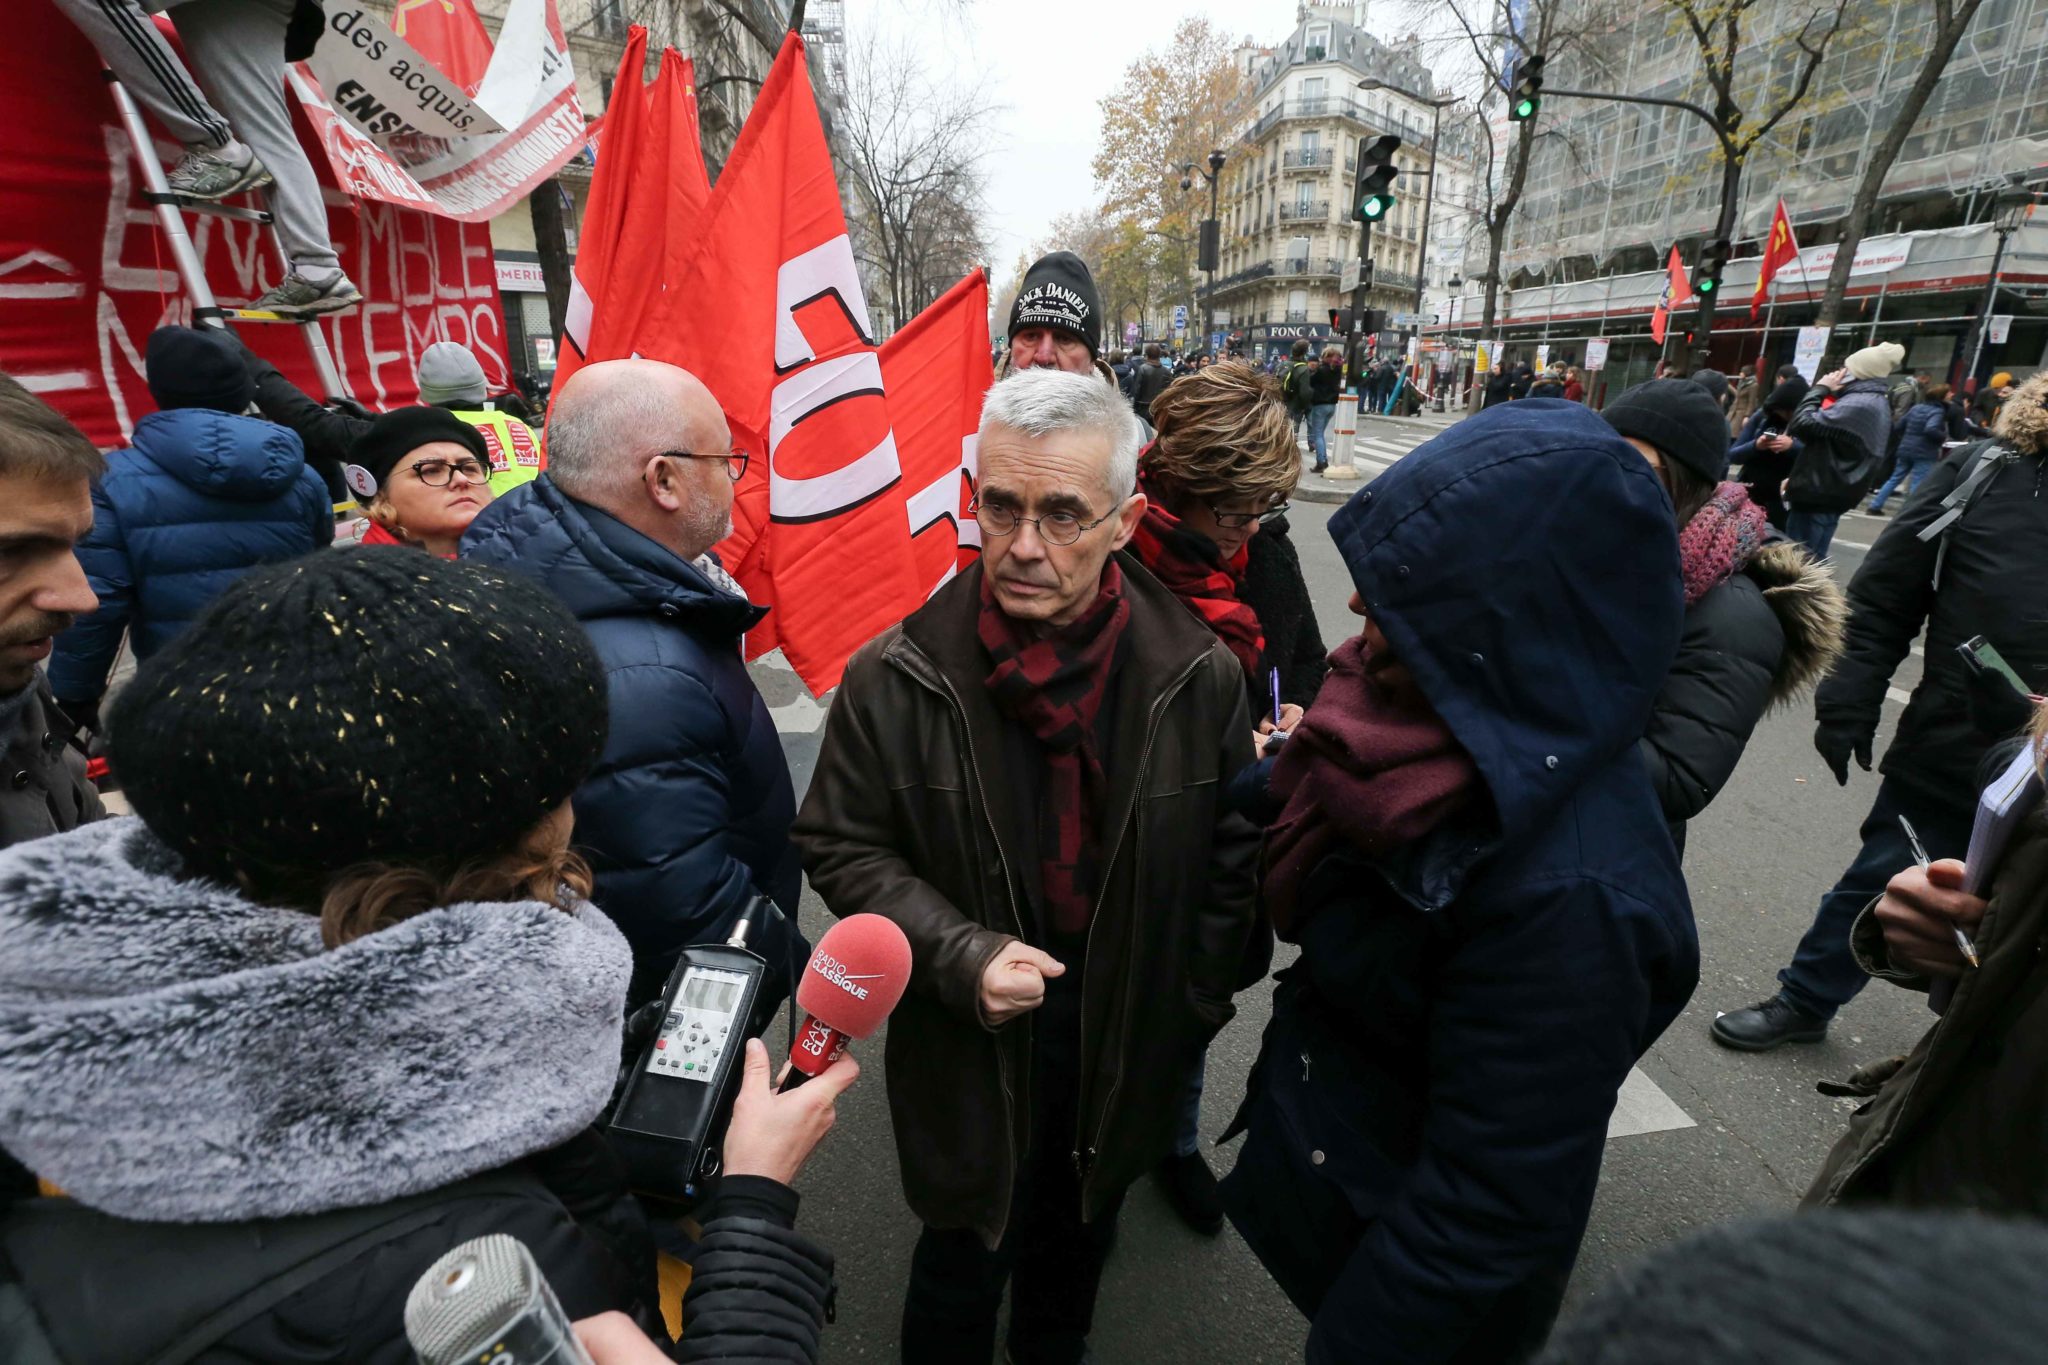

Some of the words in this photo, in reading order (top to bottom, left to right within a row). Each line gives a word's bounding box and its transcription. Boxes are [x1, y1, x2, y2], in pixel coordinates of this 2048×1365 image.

[331, 9, 388, 61] des
[1019, 286, 1043, 311] JACK
[1271, 326, 1319, 337] FONCA
[816, 949, 847, 975] RADIO
[812, 959, 869, 1001] CLASSIQUE
